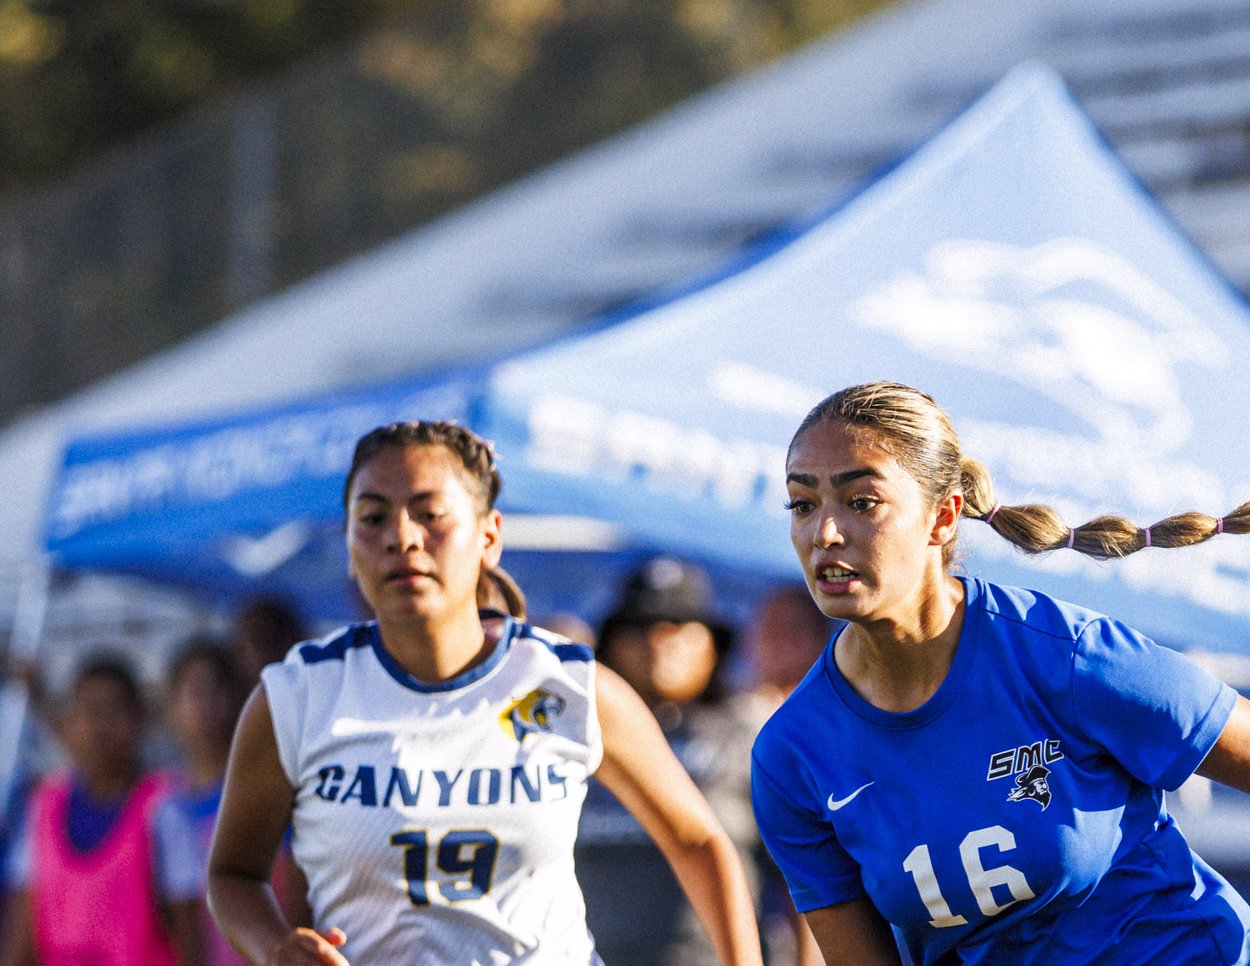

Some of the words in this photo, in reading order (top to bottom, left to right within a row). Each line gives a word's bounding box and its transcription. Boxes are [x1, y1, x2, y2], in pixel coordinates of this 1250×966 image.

[314, 764, 568, 808] CANYONS
[986, 738, 1065, 782] SMC
[389, 825, 499, 908] 19
[902, 824, 1037, 929] 16
